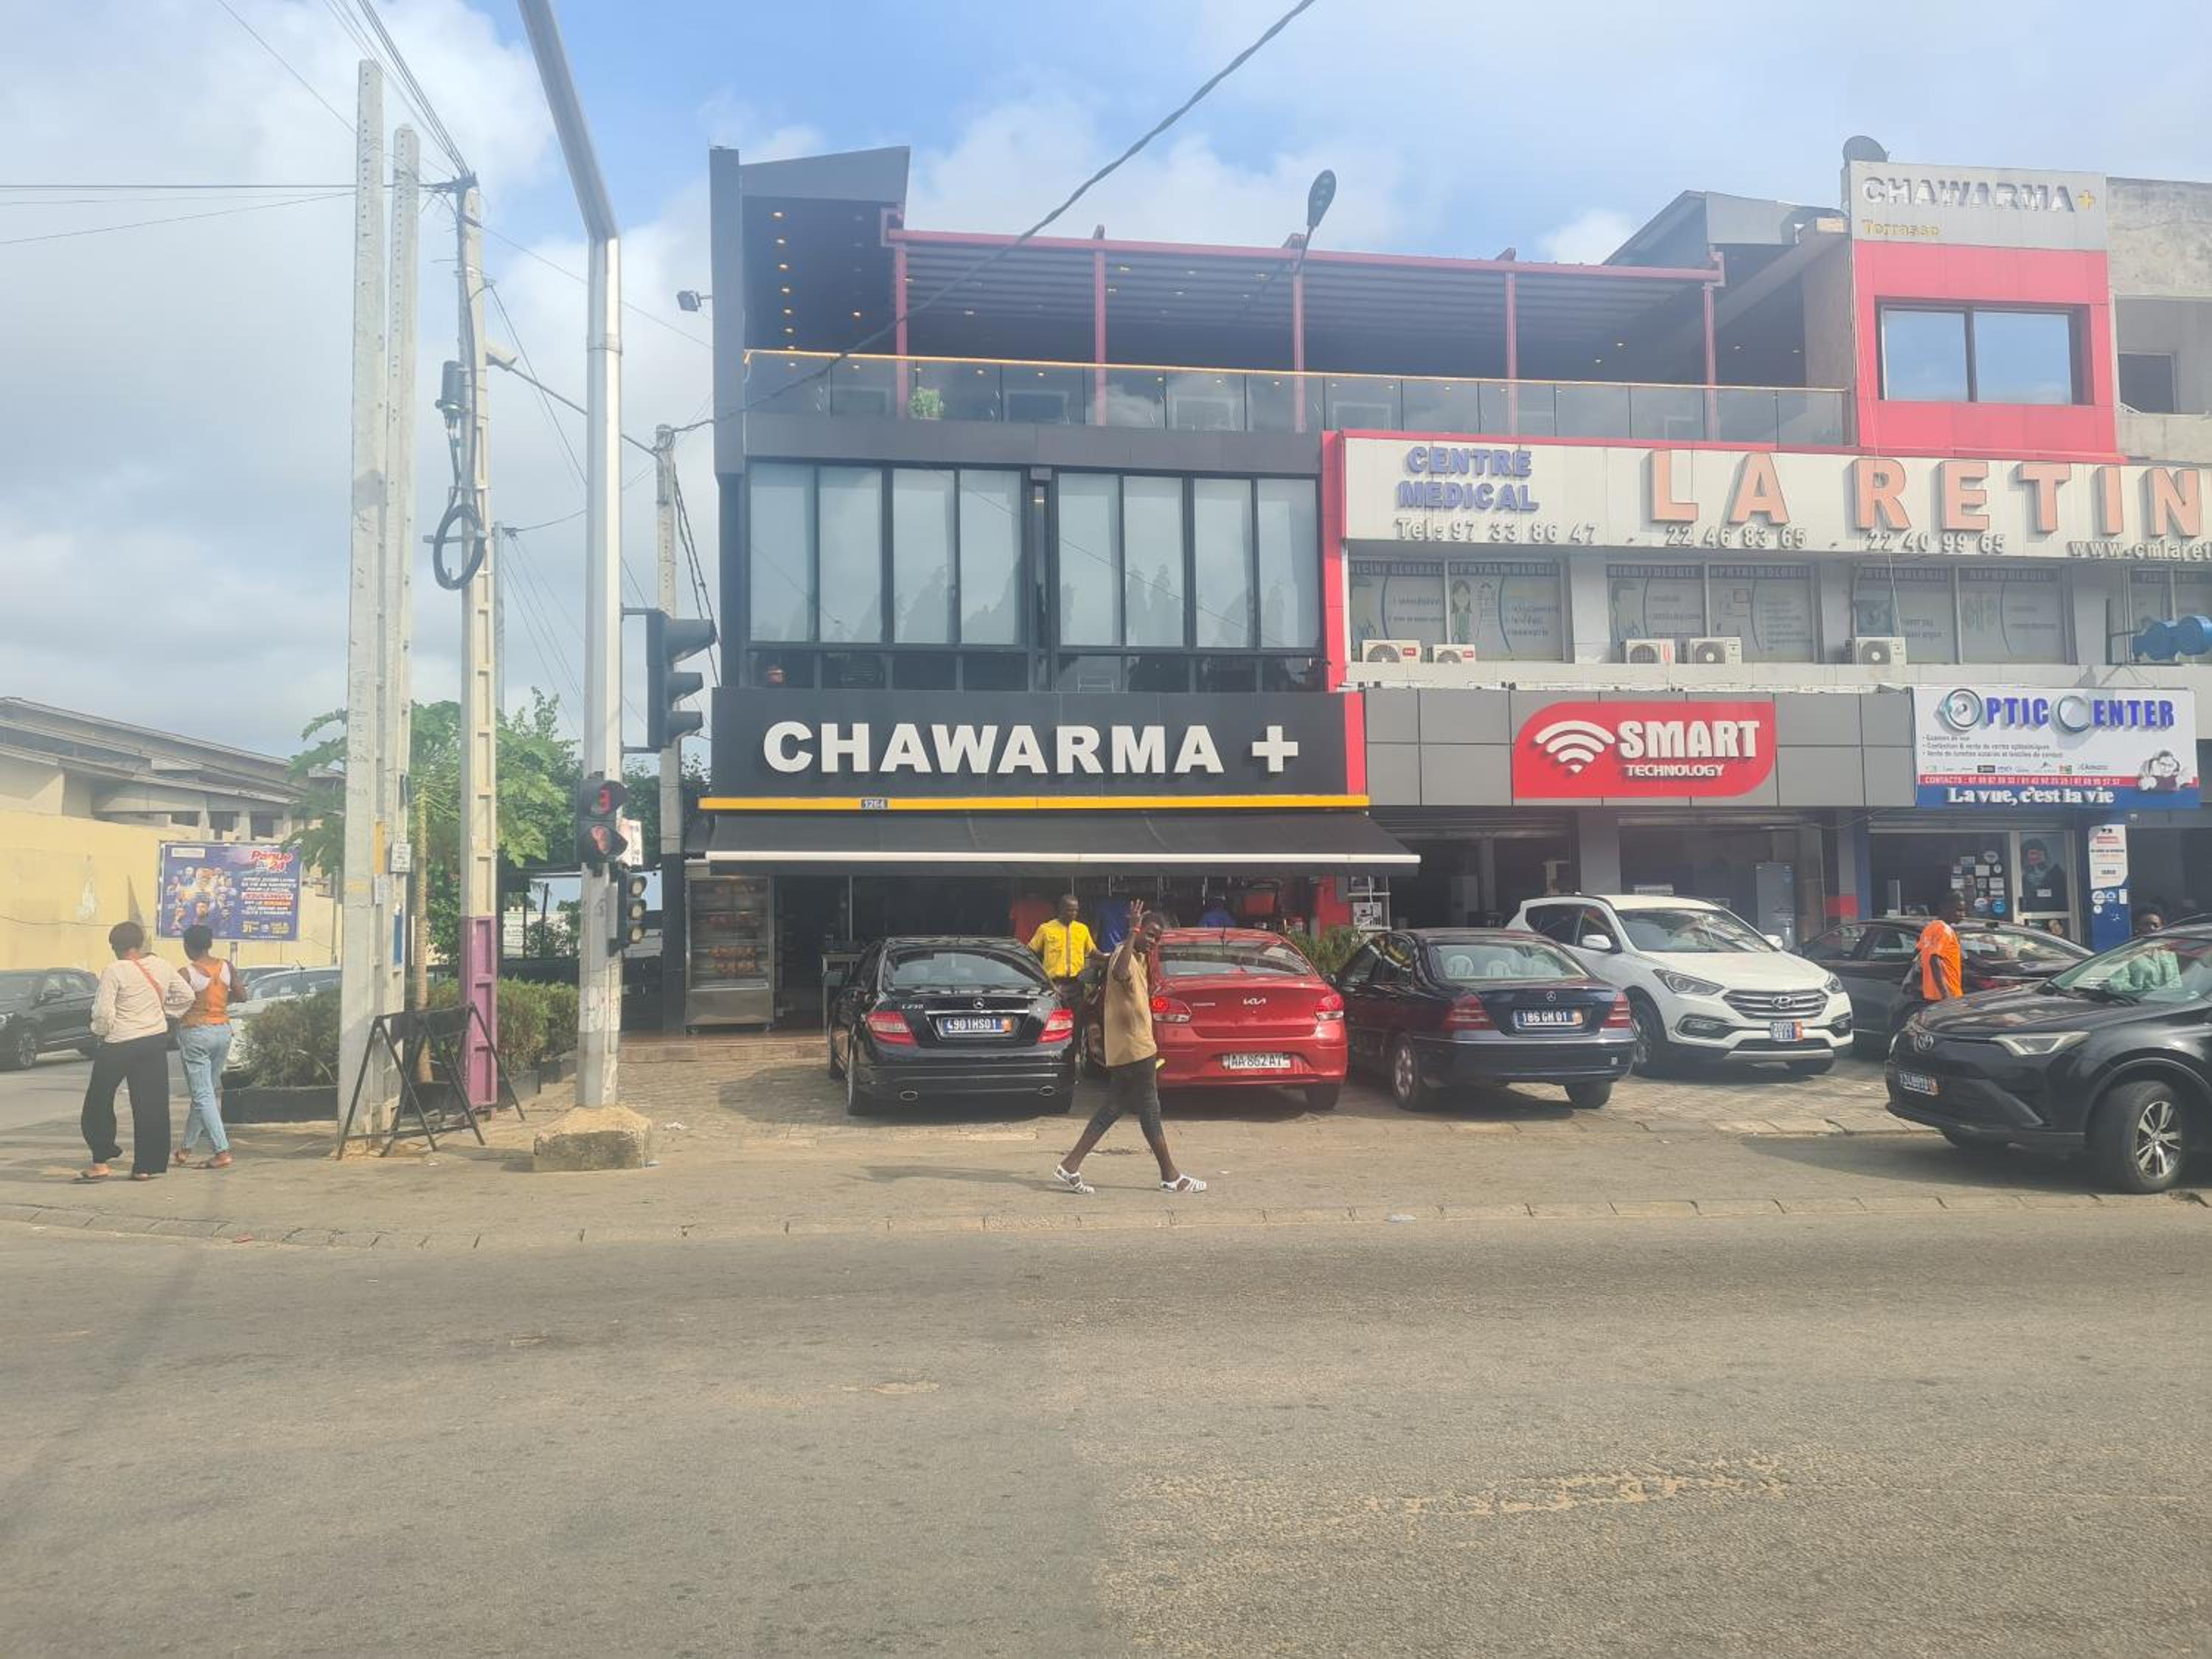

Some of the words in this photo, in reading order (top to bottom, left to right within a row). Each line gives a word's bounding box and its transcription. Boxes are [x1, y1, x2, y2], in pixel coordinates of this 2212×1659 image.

[1862, 176, 2076, 213] CHAWARMA
[1407, 446, 1532, 476] CENTRE
[1397, 480, 1540, 511] MEDICAL
[1568, 523, 1596, 544] 47
[1665, 524, 1694, 546] 22
[1701, 525, 1731, 548] 46
[1742, 524, 1769, 548] 83
[1780, 526, 1806, 549] 65
[1864, 530, 1893, 552] 22
[1941, 531, 1968, 553] 99
[1979, 533, 2006, 554] 65
[763, 720, 1224, 773] CHAWARMA
[1618, 720, 1760, 758] SMART
[1624, 764, 1725, 776] TECHNOLOGY
[1947, 787, 1975, 803] La
[2063, 788, 2083, 803] la
[2084, 787, 2115, 803] vie
